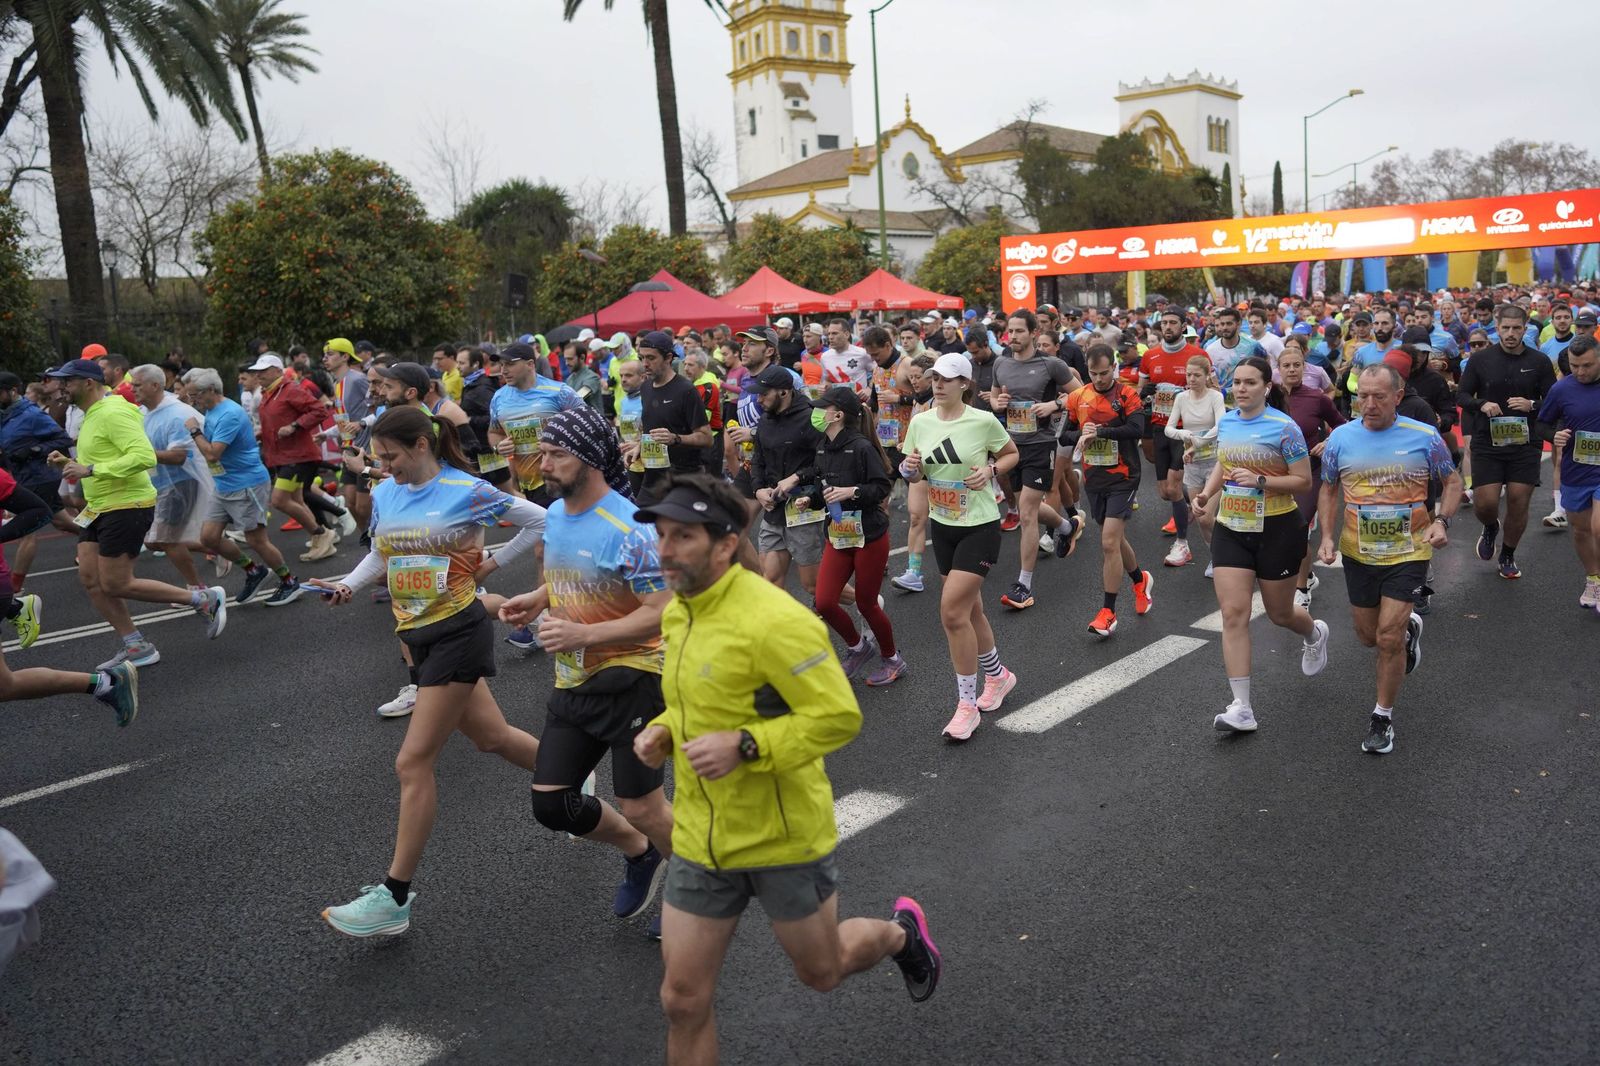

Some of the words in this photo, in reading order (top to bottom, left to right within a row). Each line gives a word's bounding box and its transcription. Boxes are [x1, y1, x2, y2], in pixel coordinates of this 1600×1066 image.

[1420, 215, 1478, 236] HOKA
[1486, 224, 1529, 234] HYUNDAI
[1154, 237, 1198, 255] HOKA
[547, 422, 581, 446] GARMIN
[1495, 424, 1522, 434] 11753
[572, 424, 605, 458] GARMIN
[1223, 496, 1256, 512] 10552
[1363, 520, 1403, 535] 10554
[396, 570, 432, 591] 9165
